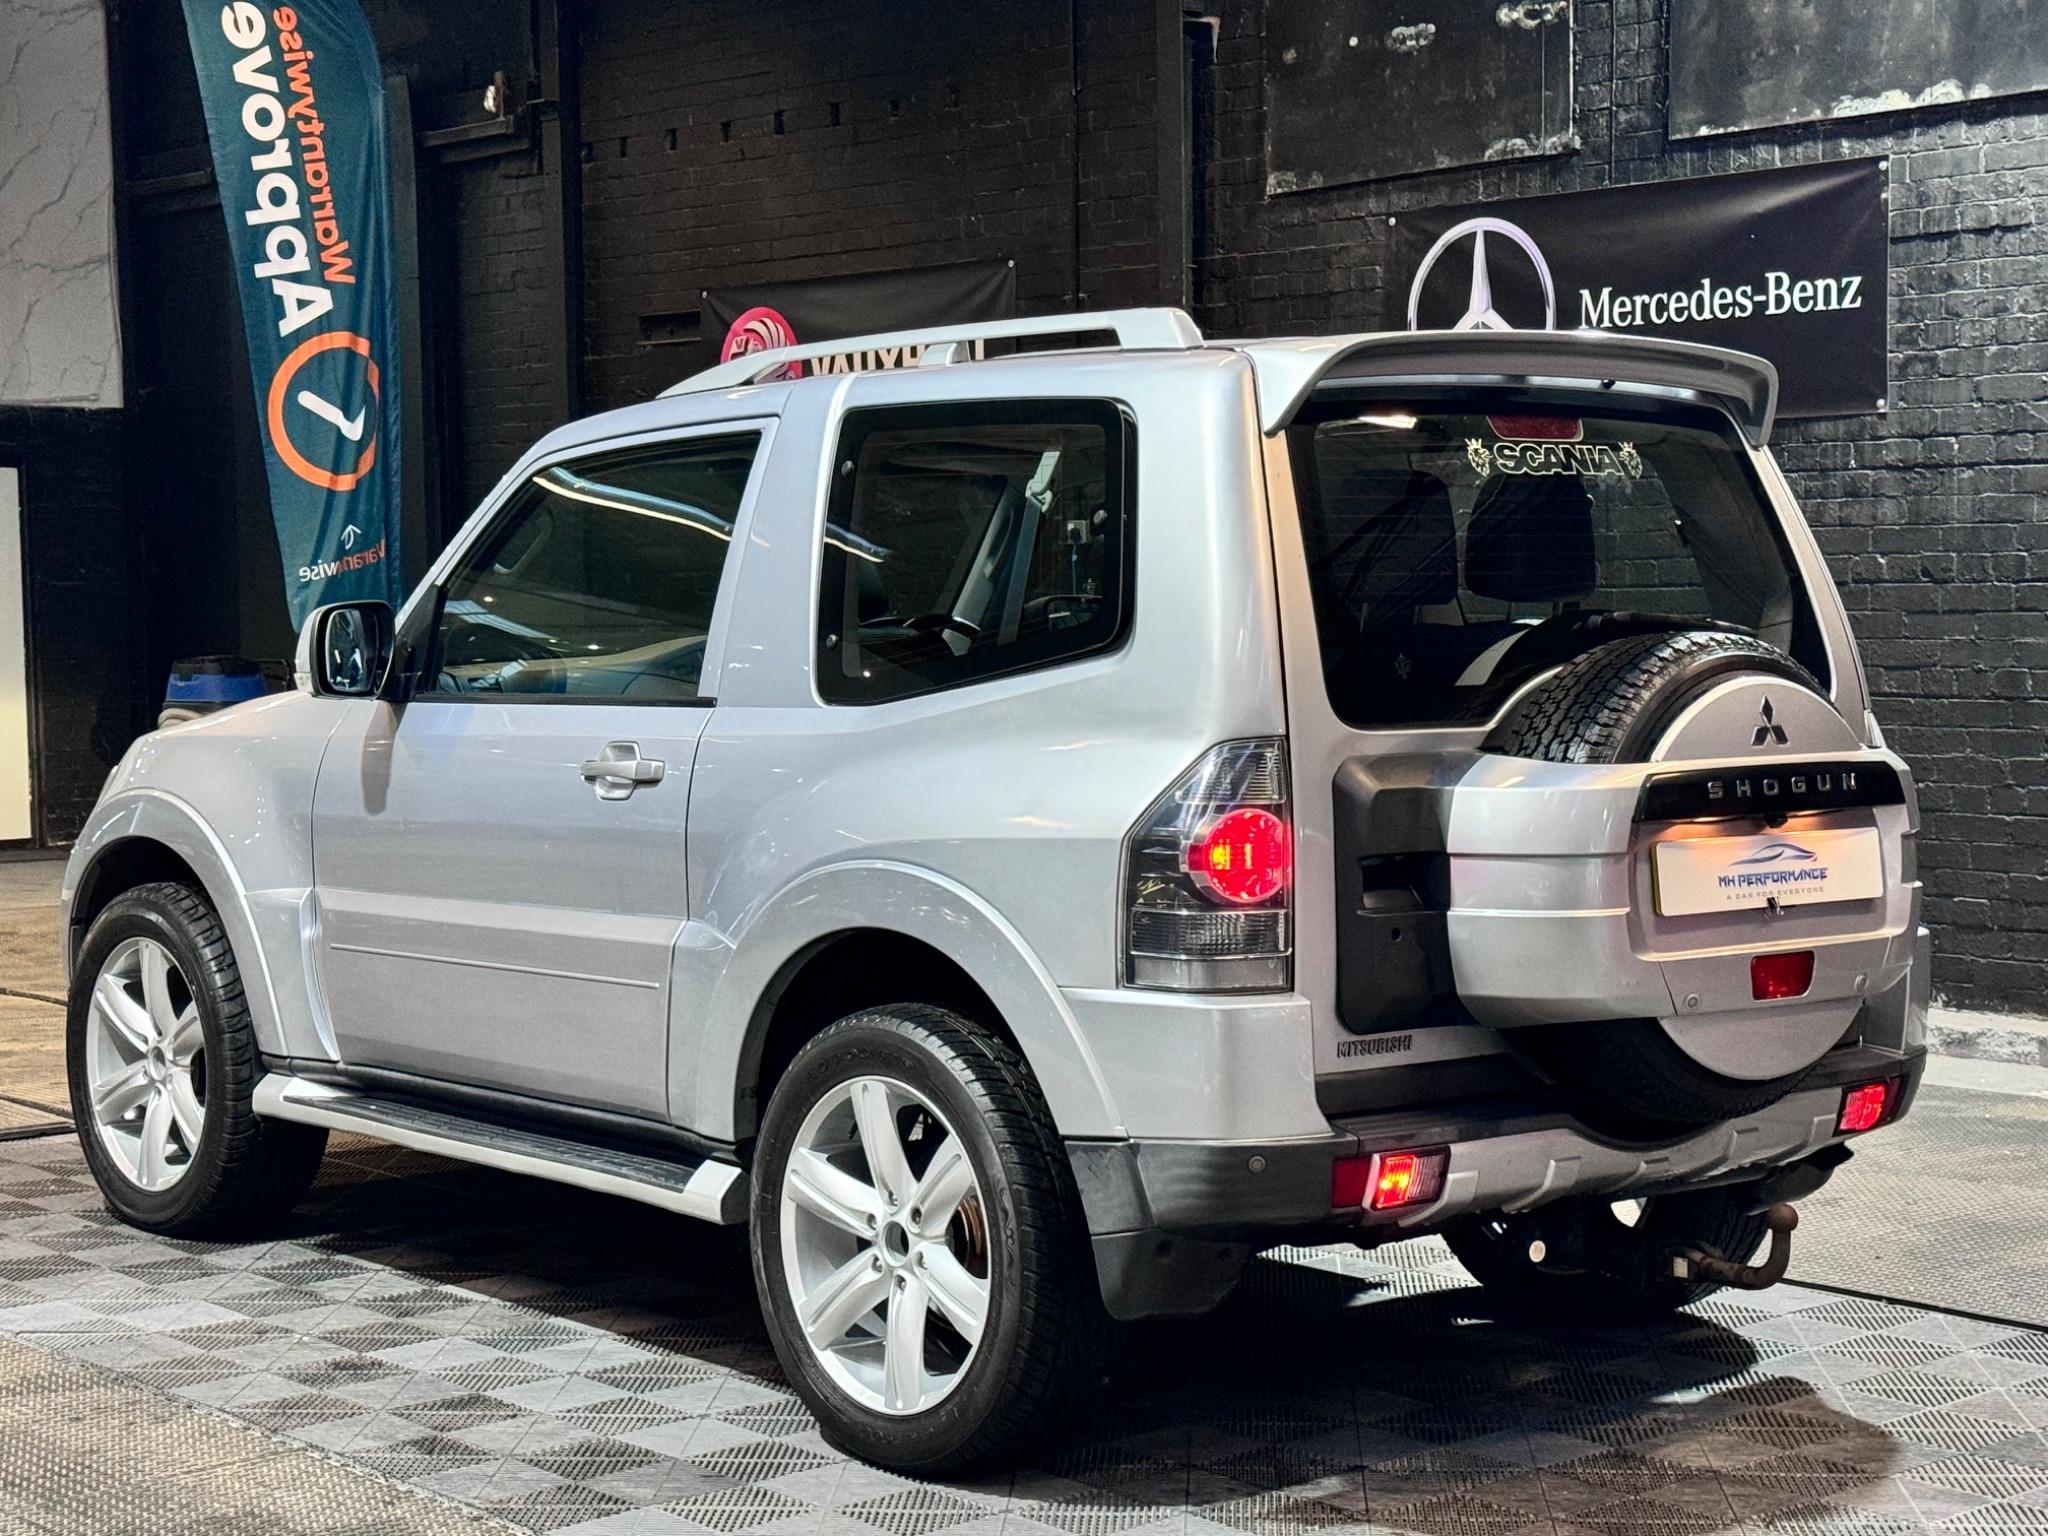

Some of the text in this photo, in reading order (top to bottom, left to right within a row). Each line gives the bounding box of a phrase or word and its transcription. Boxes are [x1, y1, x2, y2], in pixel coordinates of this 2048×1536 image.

[1579, 271, 1863, 331] Mercedes-Benz
[1494, 442, 1624, 475] SCANIA
[1707, 772, 1857, 799] SHOGUN
[1718, 867, 1829, 888] MH PERFORMANCE
[1777, 886, 1824, 896] EVERYONE
[1337, 1034, 1413, 1058] MITSUBISHI
